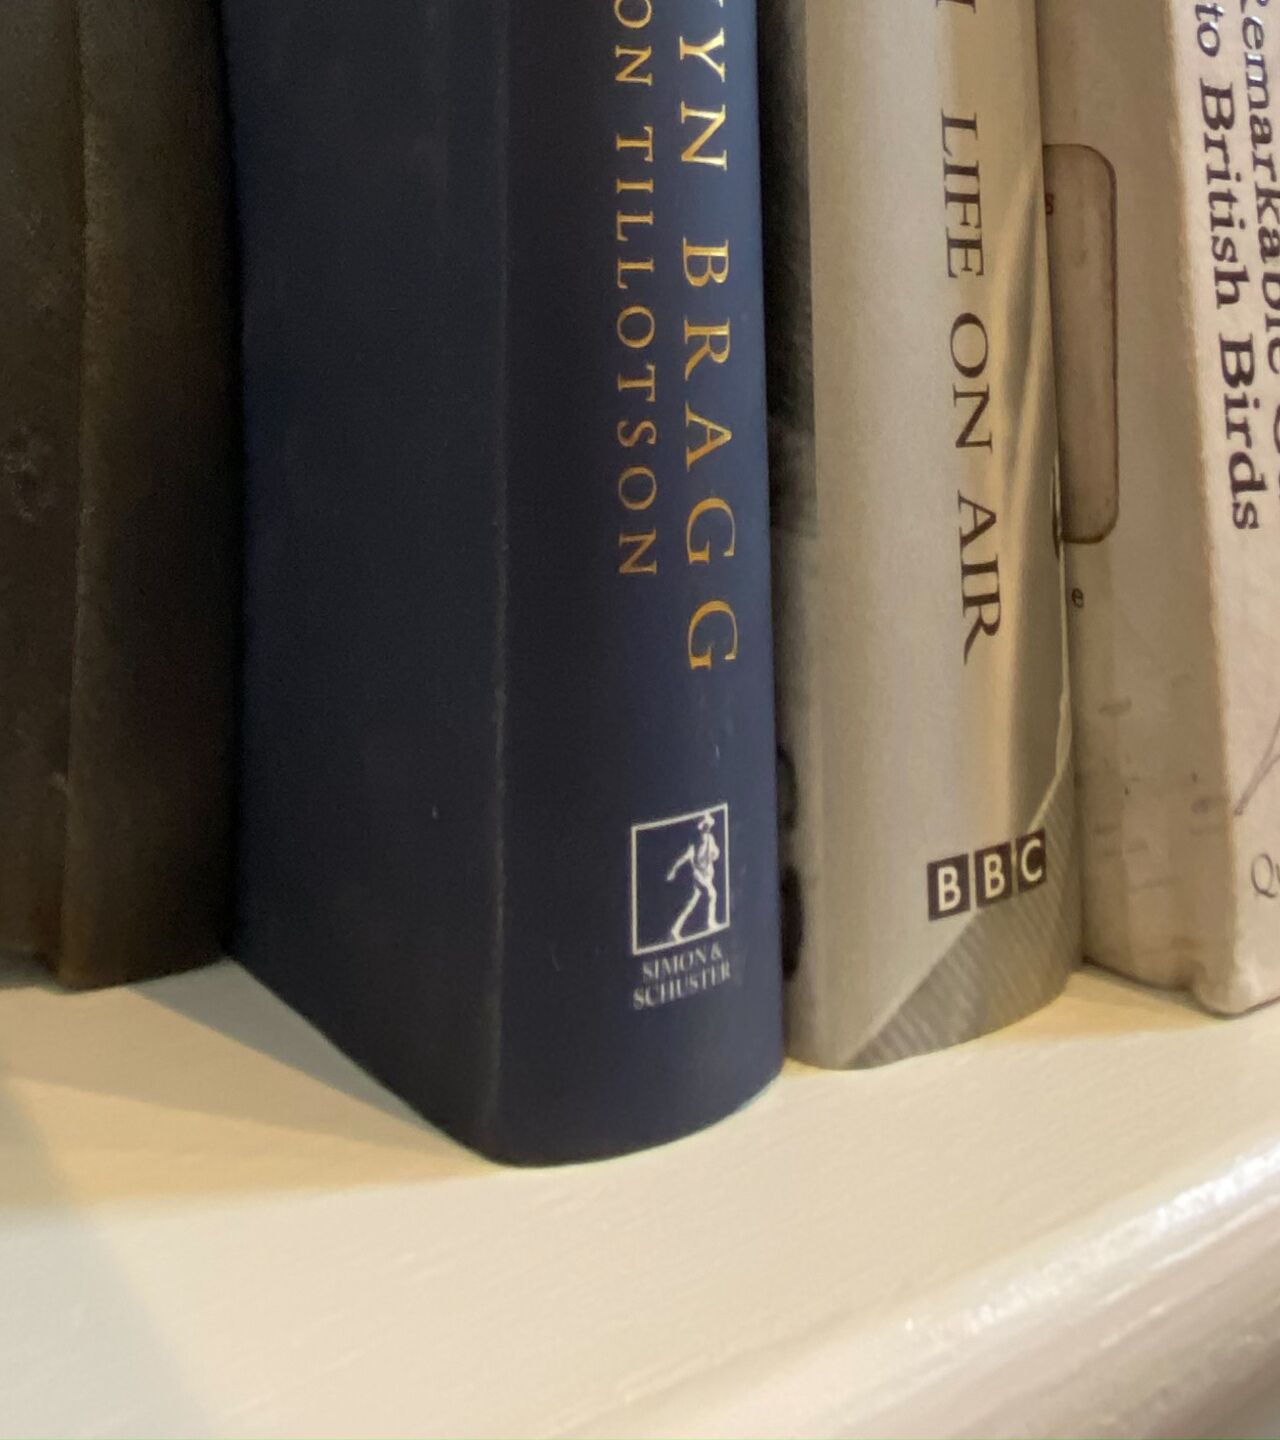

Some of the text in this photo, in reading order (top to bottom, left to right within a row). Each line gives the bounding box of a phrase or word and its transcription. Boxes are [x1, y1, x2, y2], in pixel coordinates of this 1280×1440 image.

[615, 125, 658, 577] TILLOTSON
[681, 236, 739, 672] BRAGG
[940, 107, 1002, 666] LIFE ON AIR
[1194, 1, 1269, 530] to British Birds
[632, 961, 731, 1010] SCHUSTER
[642, 941, 724, 980] SIMON &
[931, 833, 1046, 917] BBC
